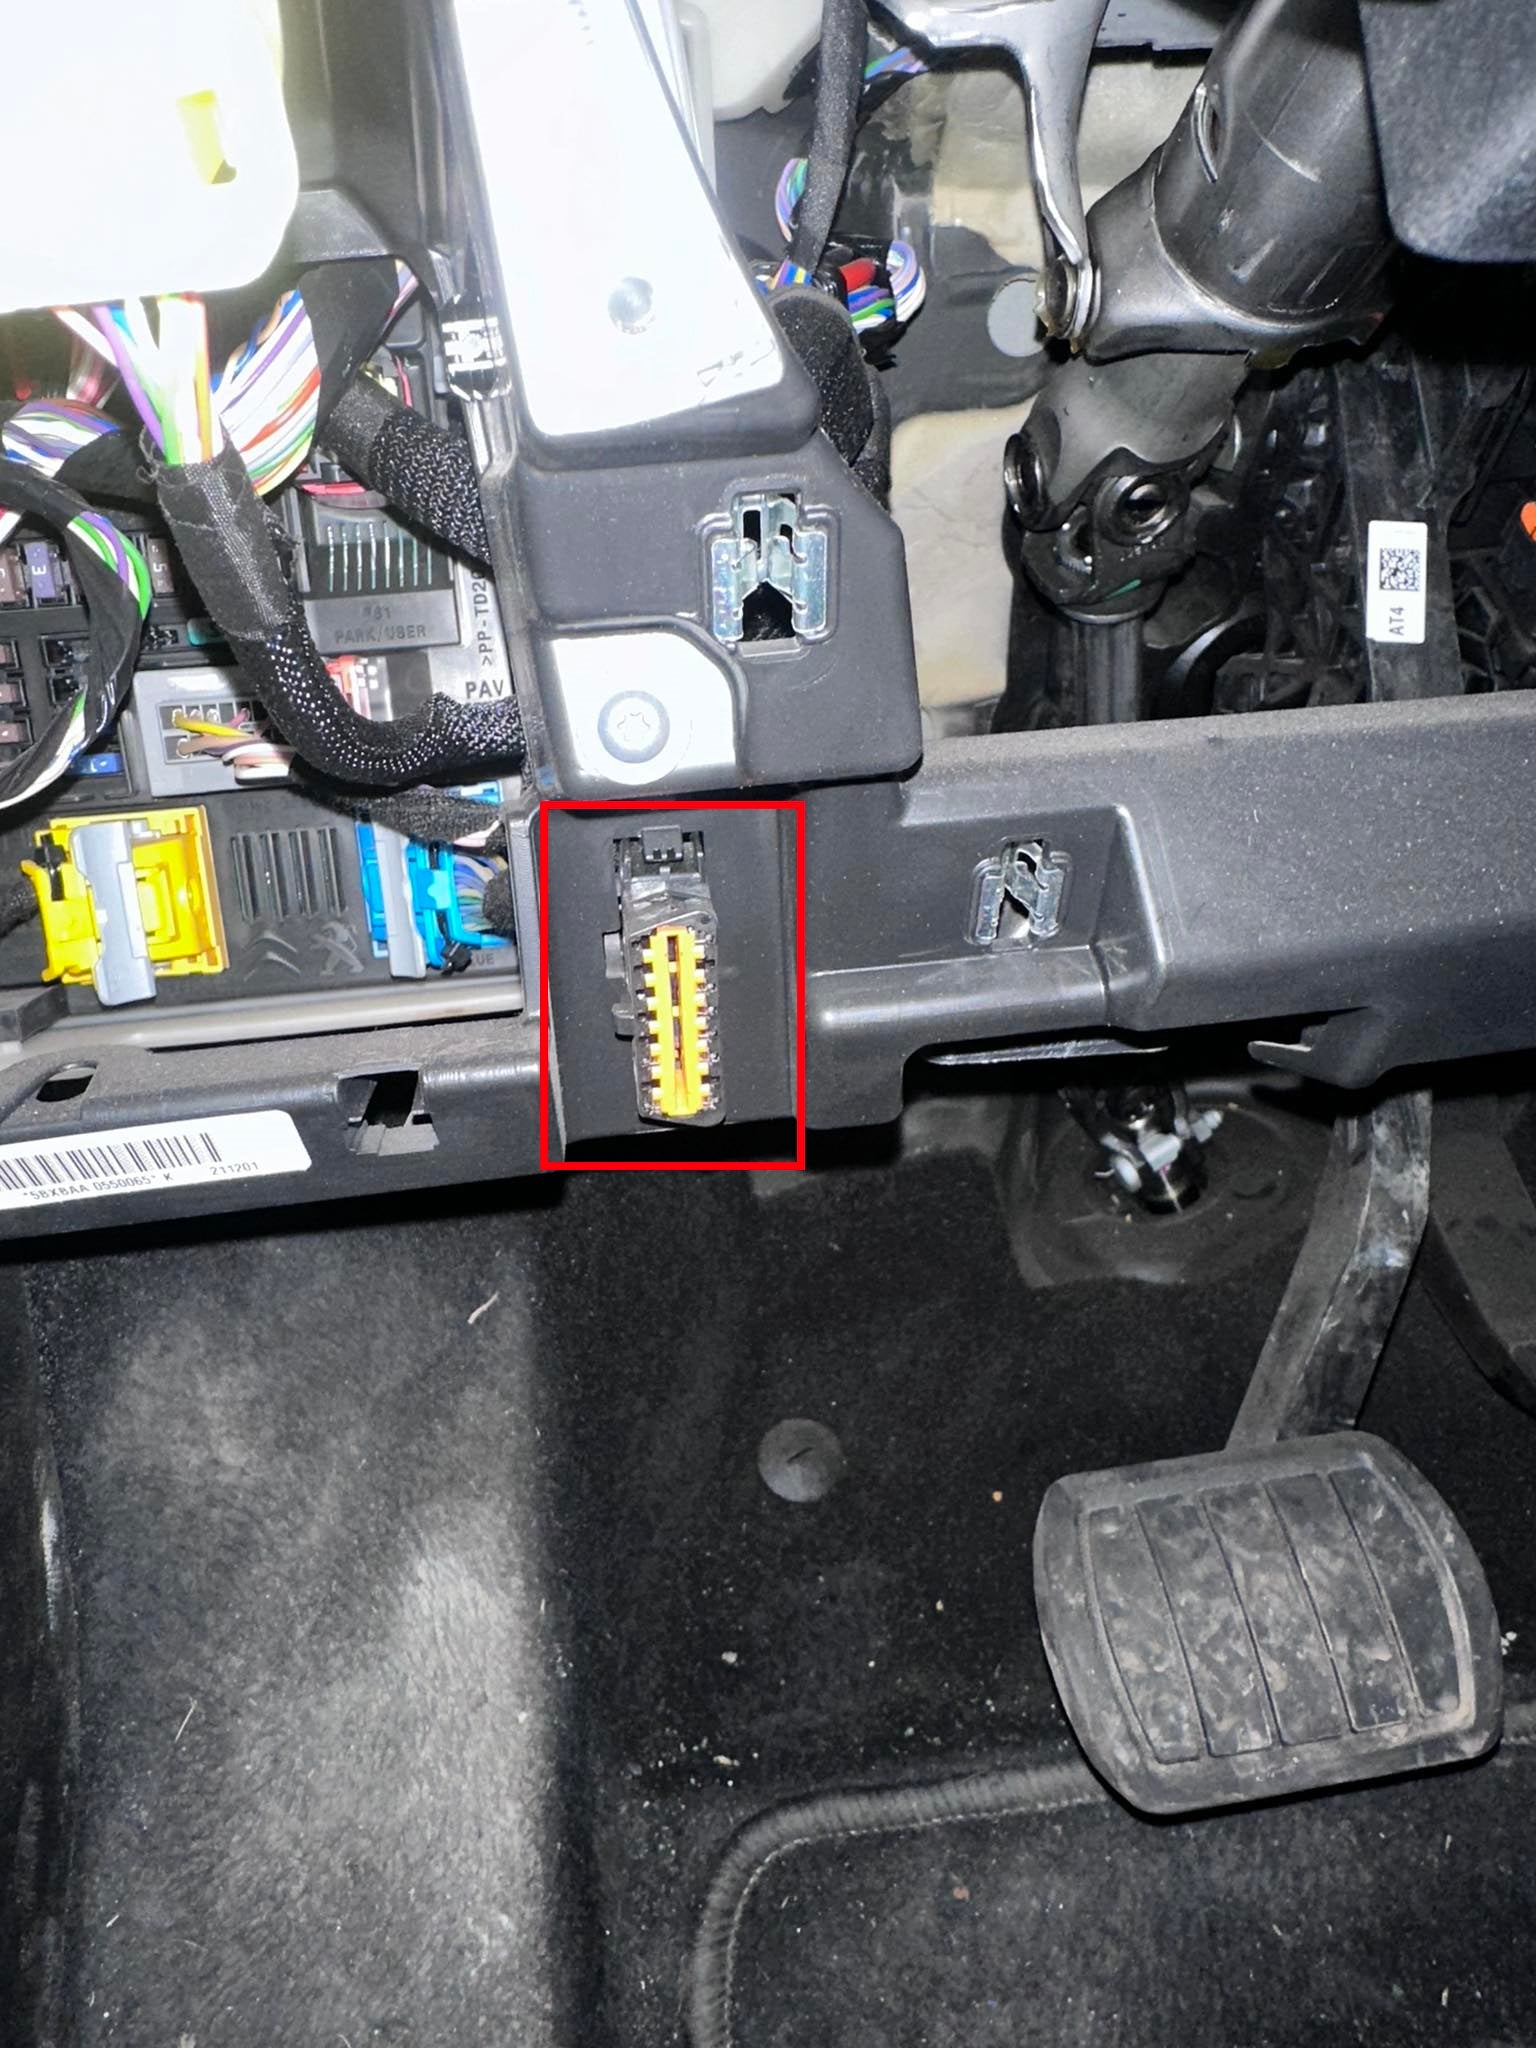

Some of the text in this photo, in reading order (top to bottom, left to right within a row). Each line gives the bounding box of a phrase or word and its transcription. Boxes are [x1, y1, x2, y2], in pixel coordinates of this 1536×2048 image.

[1389, 607, 1404, 636] AT4
[465, 679, 504, 699] PAV
[210, 1161, 260, 1176] 211201
